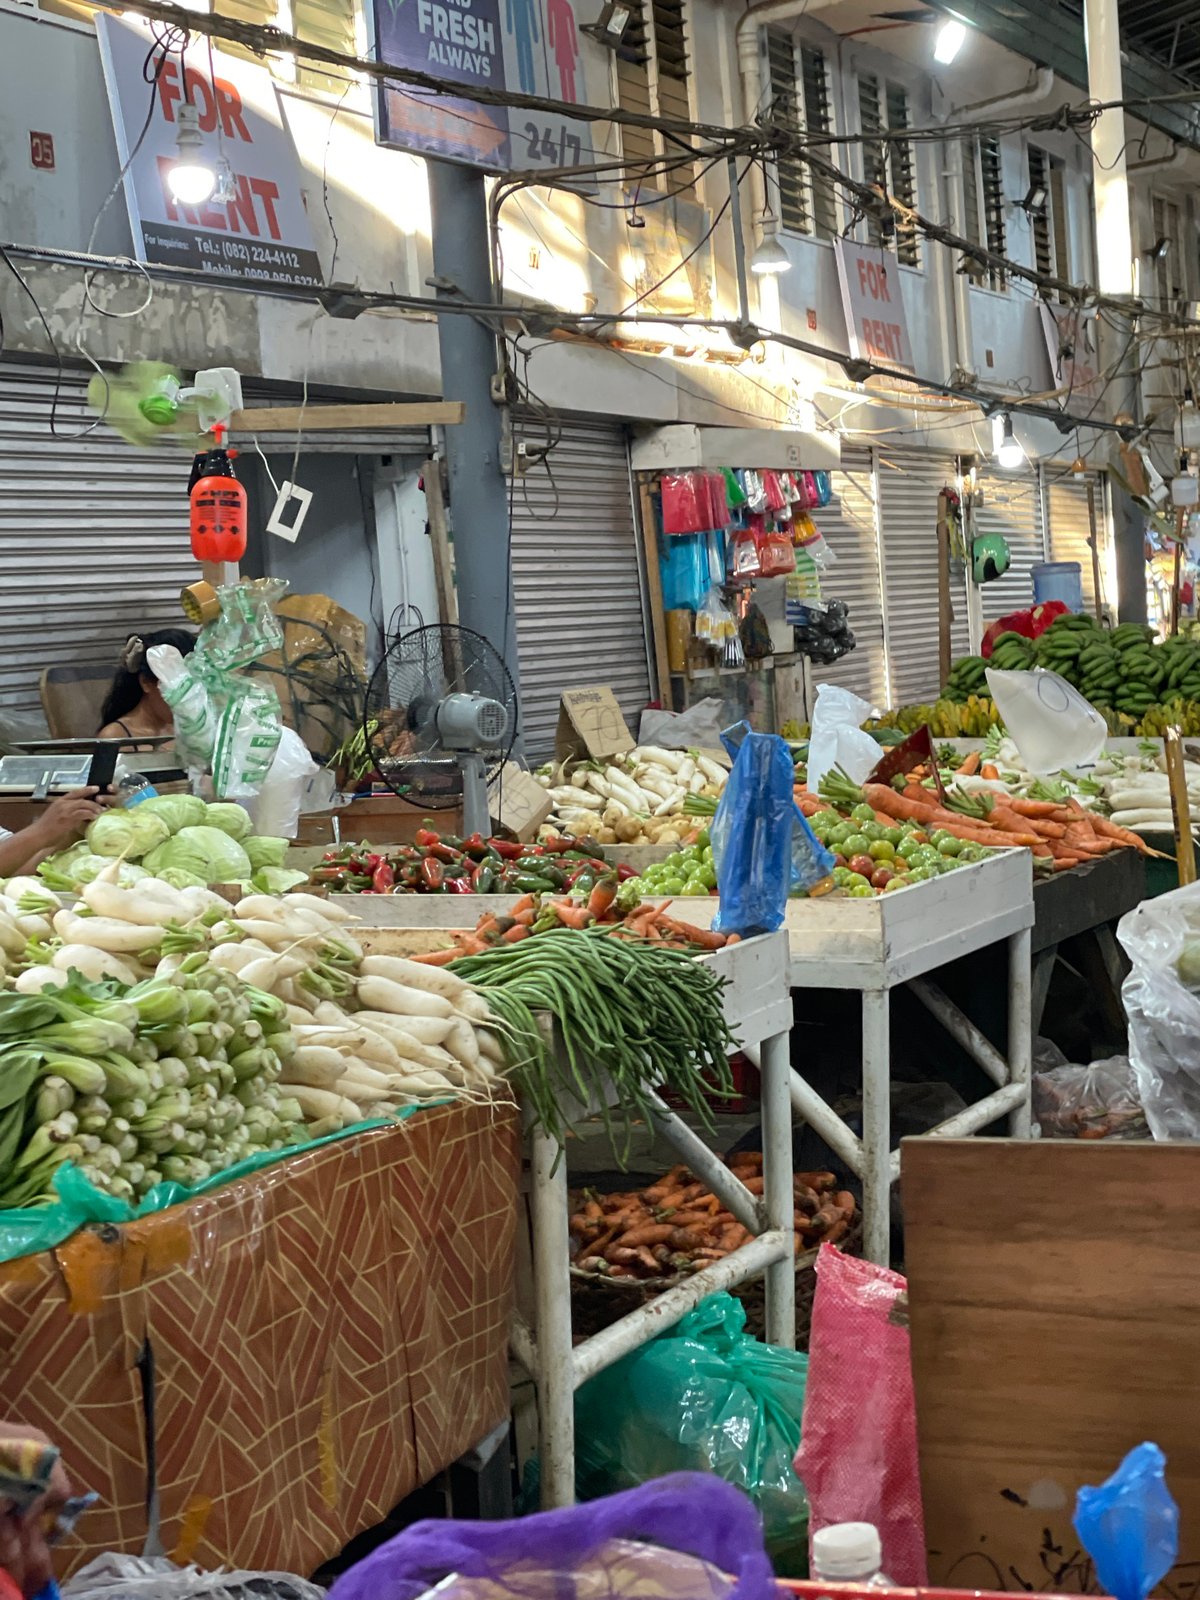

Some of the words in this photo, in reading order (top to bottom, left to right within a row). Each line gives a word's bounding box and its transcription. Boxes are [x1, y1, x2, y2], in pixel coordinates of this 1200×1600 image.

[417, 0, 496, 55] FRESH
[428, 41, 491, 78] ALWAYS
[152, 56, 253, 143] FOR
[525, 122, 580, 168] 24/7
[195, 236, 220, 255] Tel.:
[222, 241, 250, 263] (082)
[251, 246, 300, 268] 224-4112
[856, 258, 891, 302] FOR
[862, 317, 903, 361] RENT
